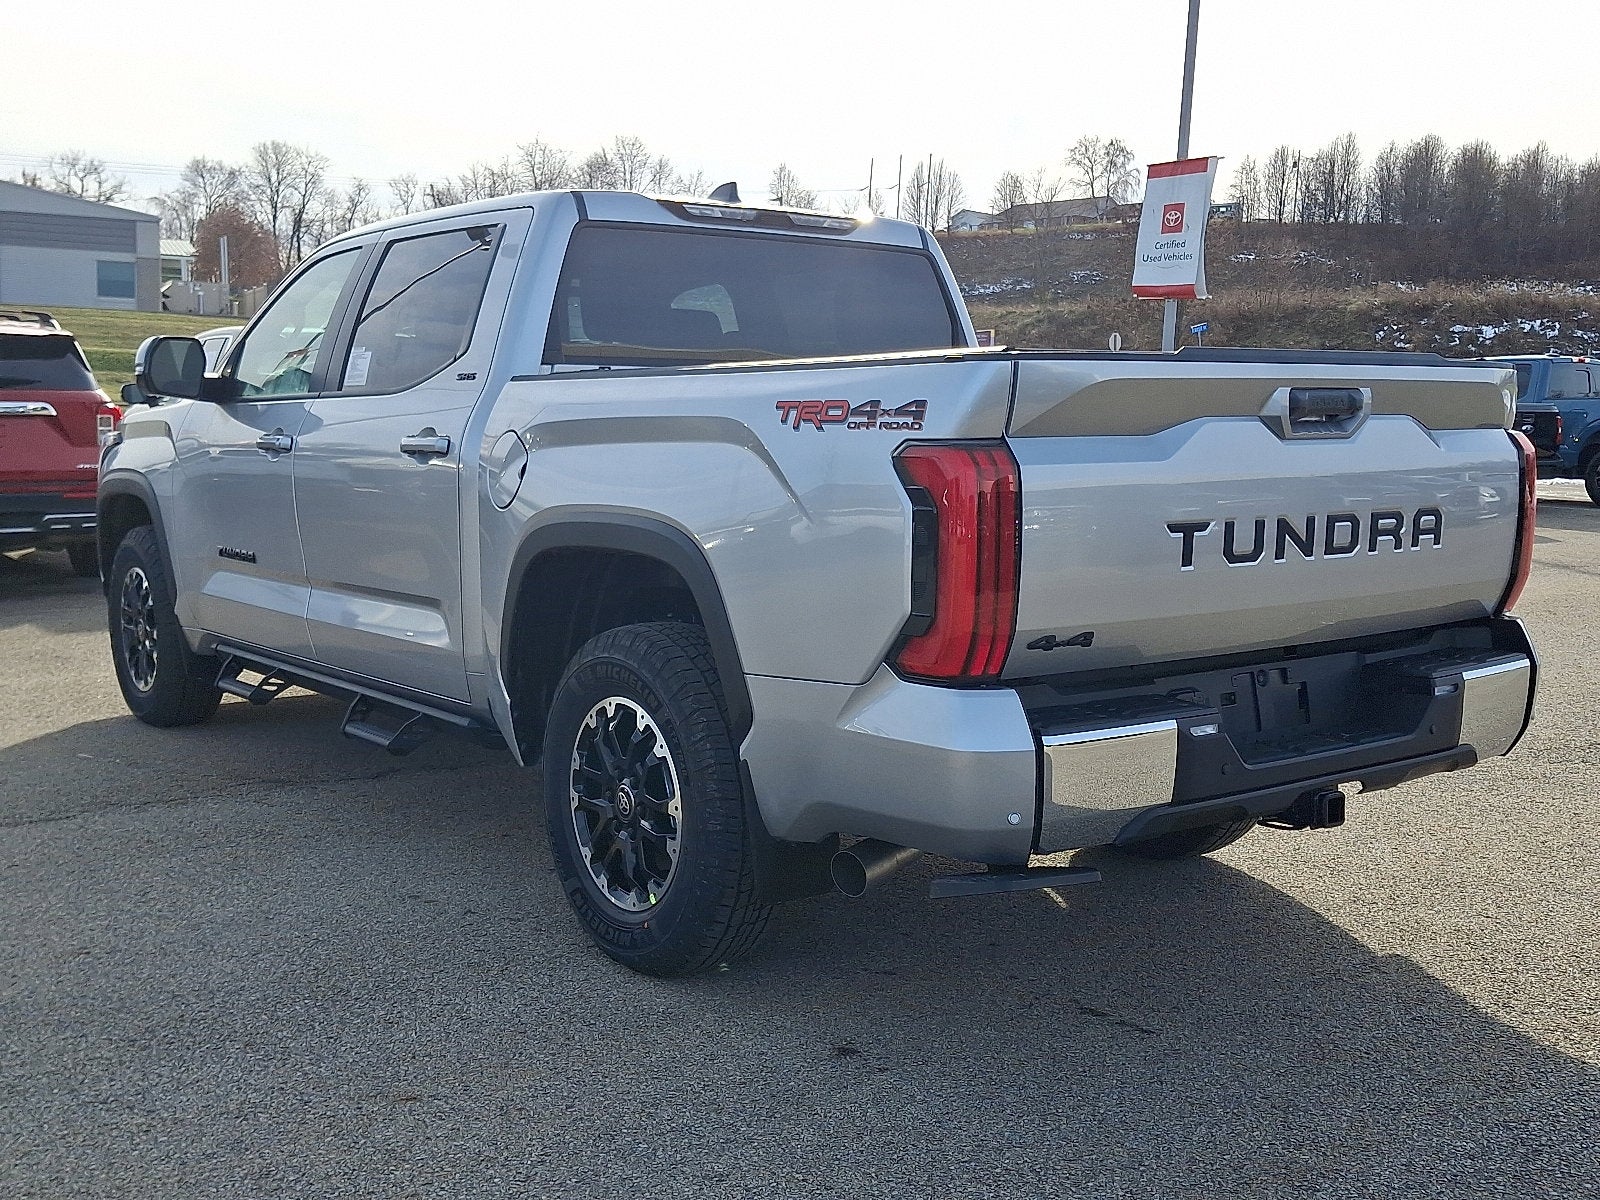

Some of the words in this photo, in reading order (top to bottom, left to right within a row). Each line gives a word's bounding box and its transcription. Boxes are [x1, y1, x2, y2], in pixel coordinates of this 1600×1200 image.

[1154, 239, 1187, 250] Certified
[1142, 253, 1162, 262] Used
[1163, 251, 1193, 261] Vehicles
[776, 400, 850, 432] TRD
[847, 422, 877, 432] OFF
[878, 422, 924, 432] ROAD
[1165, 507, 1443, 571] TUNDRA
[217, 545, 257, 564] TUNDRA
[596, 664, 661, 711] MICHELIN
